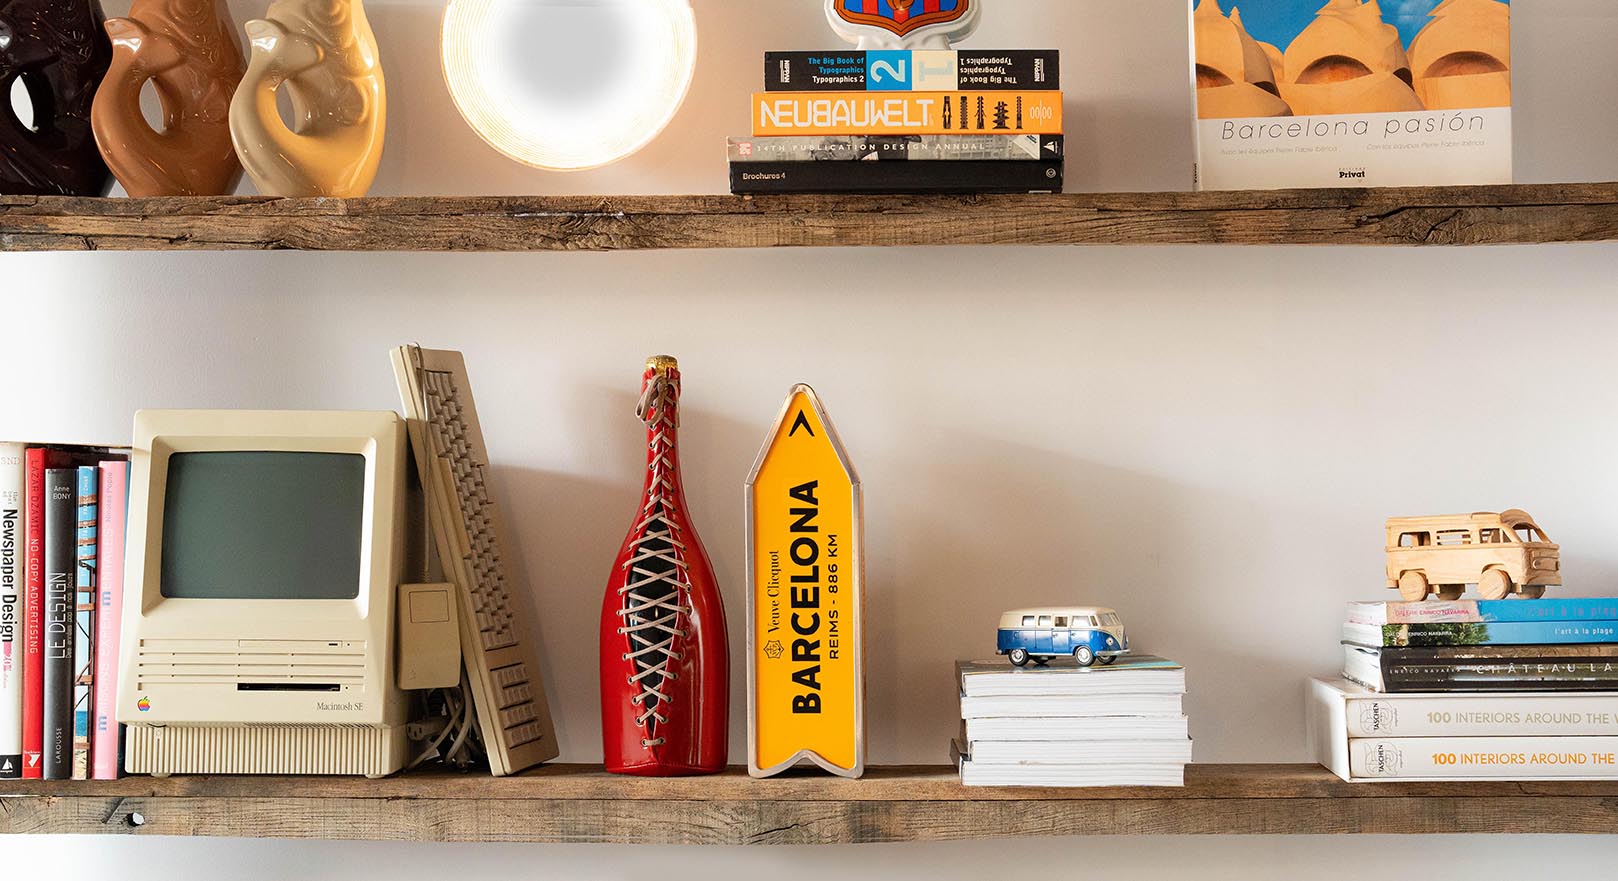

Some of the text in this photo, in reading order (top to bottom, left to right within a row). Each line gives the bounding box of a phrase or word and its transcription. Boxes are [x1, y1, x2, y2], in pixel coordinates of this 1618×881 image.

[808, 57, 865, 66] The Big Book of
[966, 57, 1013, 66] Typographics
[819, 66, 864, 75] Typographics
[870, 59, 906, 83] 2
[960, 67, 1006, 75] Typographics
[812, 75, 865, 84] Typographics 2
[960, 76, 1017, 84] The Big Book of
[760, 99, 934, 127] NEUBAUWELT
[1222, 112, 1484, 140] Barcelona pasión
[742, 172, 780, 180] Brochures
[1339, 170, 1365, 178] Privat
[31, 460, 39, 491] LAZAR
[827, 534, 838, 557] KM
[30, 538, 39, 582] NO-COPY
[0, 509, 18, 642] Newspaper Design
[828, 563, 838, 593] 886
[767, 550, 781, 633] Veuve Clicquot
[789, 480, 821, 714] BARCELONA
[30, 586, 39, 654] ADVERTISING
[48, 572, 67, 659] LE DESIGN
[829, 610, 839, 659] REIMS
[1592, 627, 1614, 636] plage
[1476, 662, 1613, 674] CHÂTEAU LA
[317, 701, 363, 711] Macintosh SE
[1426, 712, 1451, 723] 100
[1455, 712, 1520, 724] INTERIORS
[1524, 712, 1582, 724] AROUND
[1586, 712, 1609, 724] THE
[1432, 753, 1616, 765] 100 INTERIORS AROUND THE
